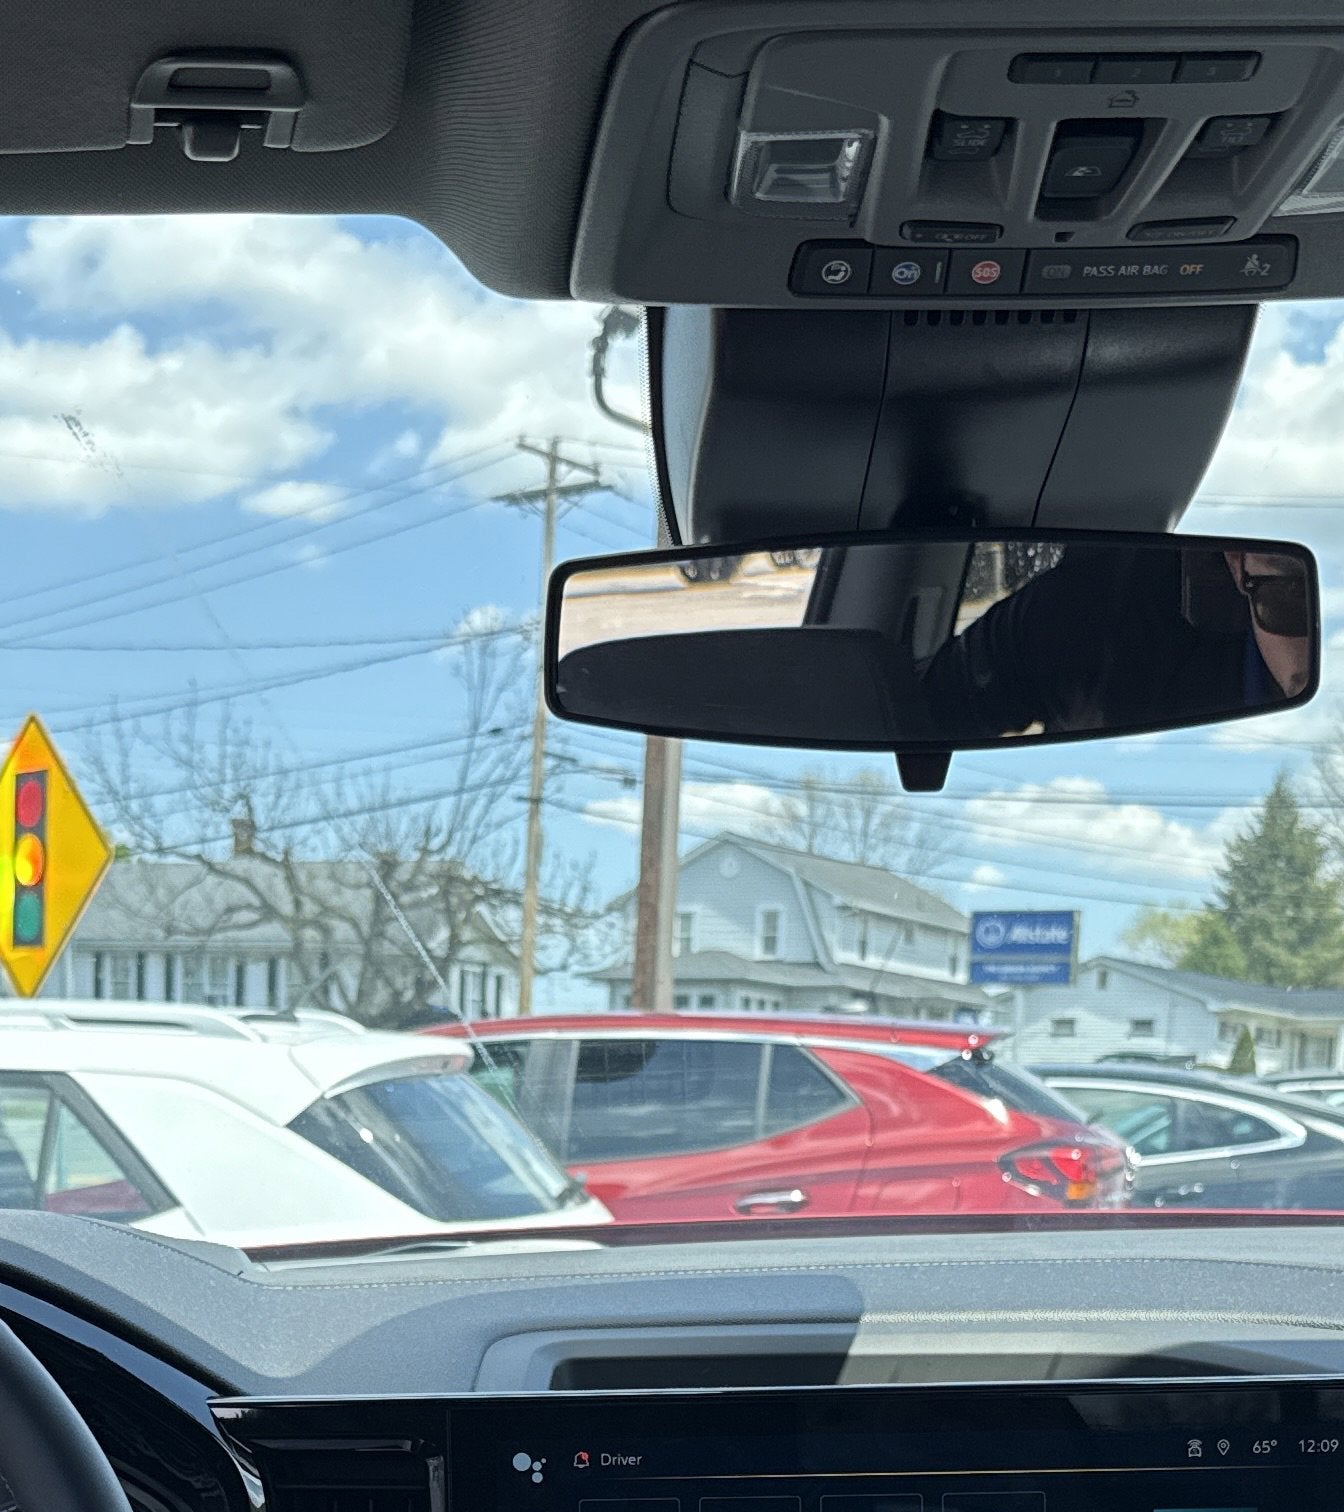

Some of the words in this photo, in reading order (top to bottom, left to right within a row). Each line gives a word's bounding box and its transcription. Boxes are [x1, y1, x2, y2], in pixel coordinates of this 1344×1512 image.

[974, 266, 998, 279] SOS
[1083, 265, 1115, 277] PASS
[1118, 265, 1139, 276] AIR
[1142, 264, 1168, 276] BAG
[1179, 264, 1203, 276] OFF
[1252, 1440, 1278, 1454] 65°
[1298, 1439, 1339, 1453] 12:09
[600, 1452, 642, 1468] Driver
